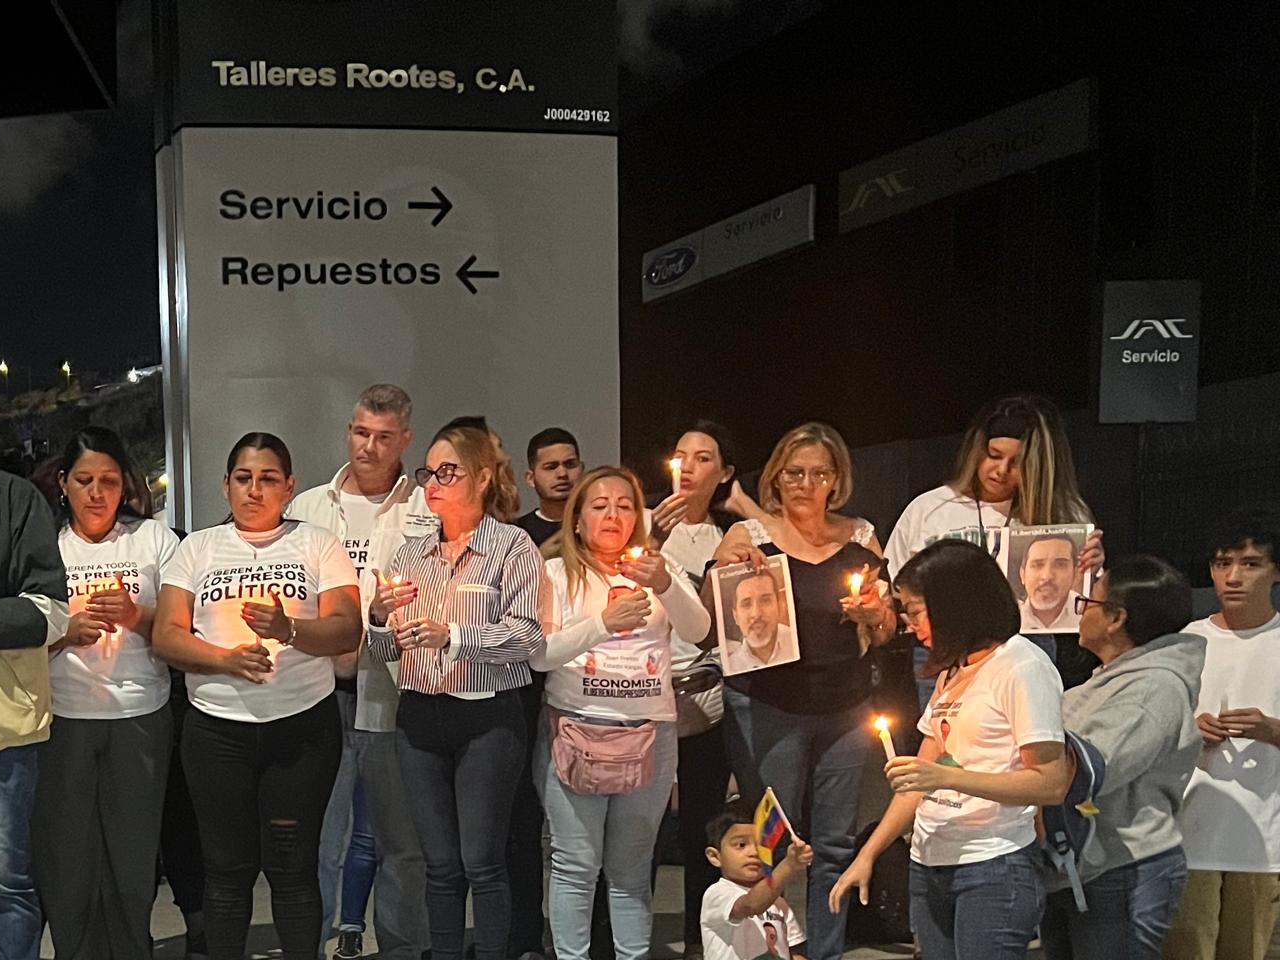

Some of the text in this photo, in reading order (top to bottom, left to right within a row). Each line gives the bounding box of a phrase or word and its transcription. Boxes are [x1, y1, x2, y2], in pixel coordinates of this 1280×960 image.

[212, 61, 536, 93] Talleres Rootes, C.A.
[544, 108, 610, 122] J000429162
[219, 189, 389, 220] Servicio
[221, 256, 442, 291] Repuestos
[1122, 348, 1181, 364] Servicio
[203, 570, 307, 590] LOS PRESOS
[582, 677, 662, 689] ECONOMISTA
